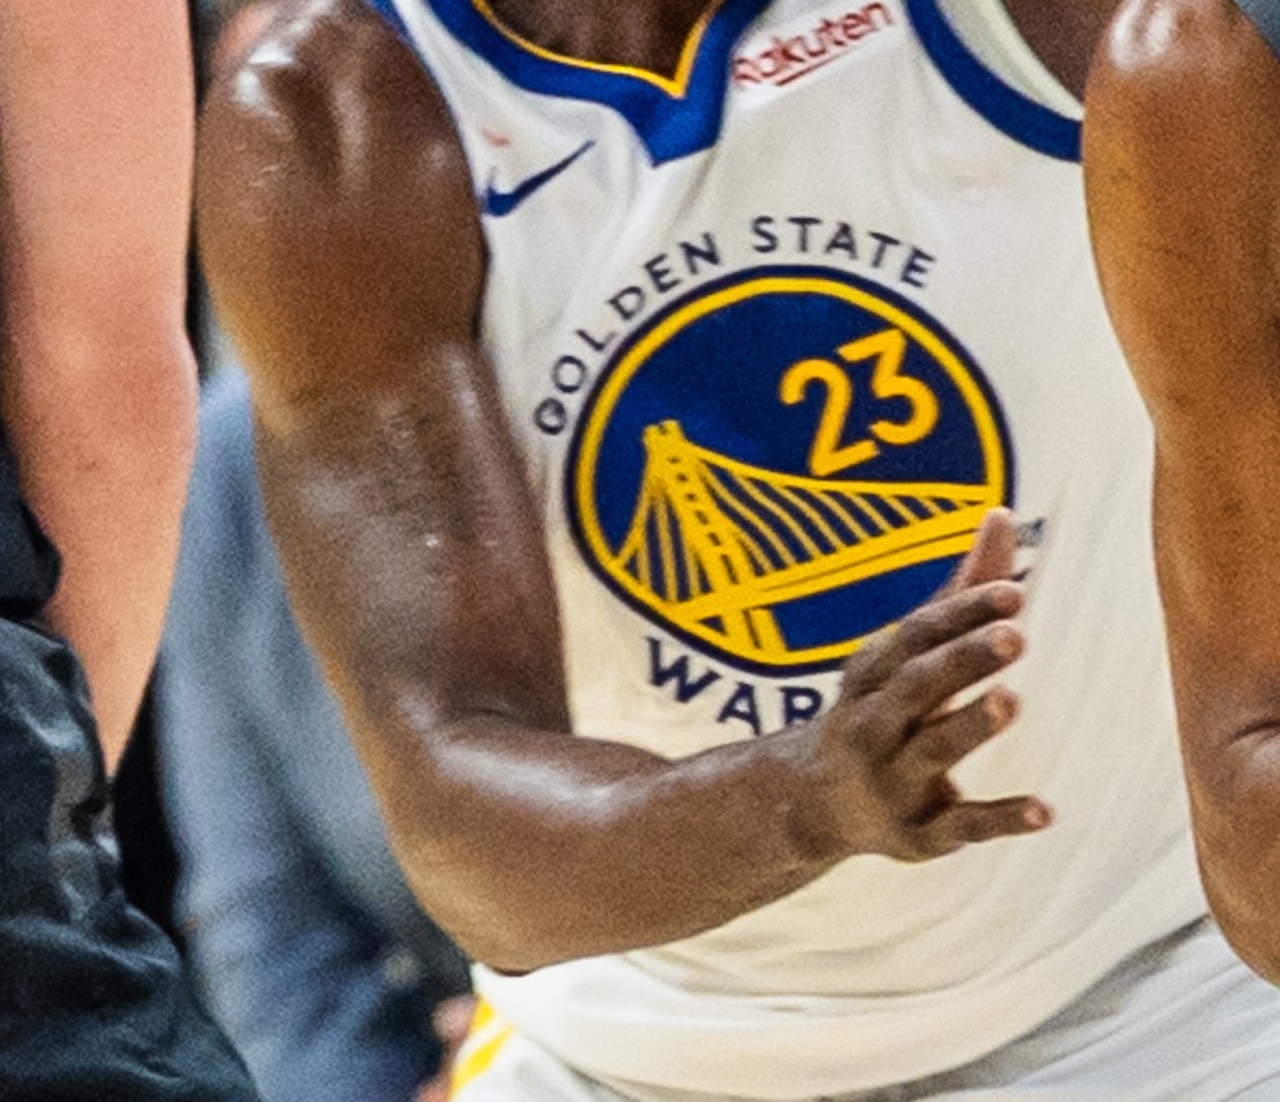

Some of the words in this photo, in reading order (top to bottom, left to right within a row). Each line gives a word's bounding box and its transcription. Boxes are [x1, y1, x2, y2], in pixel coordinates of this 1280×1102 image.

[732, 1, 893, 88] Rakuten
[534, 232, 720, 436] GOLDEN
[751, 215, 937, 289] STATE
[778, 327, 940, 477] 23
